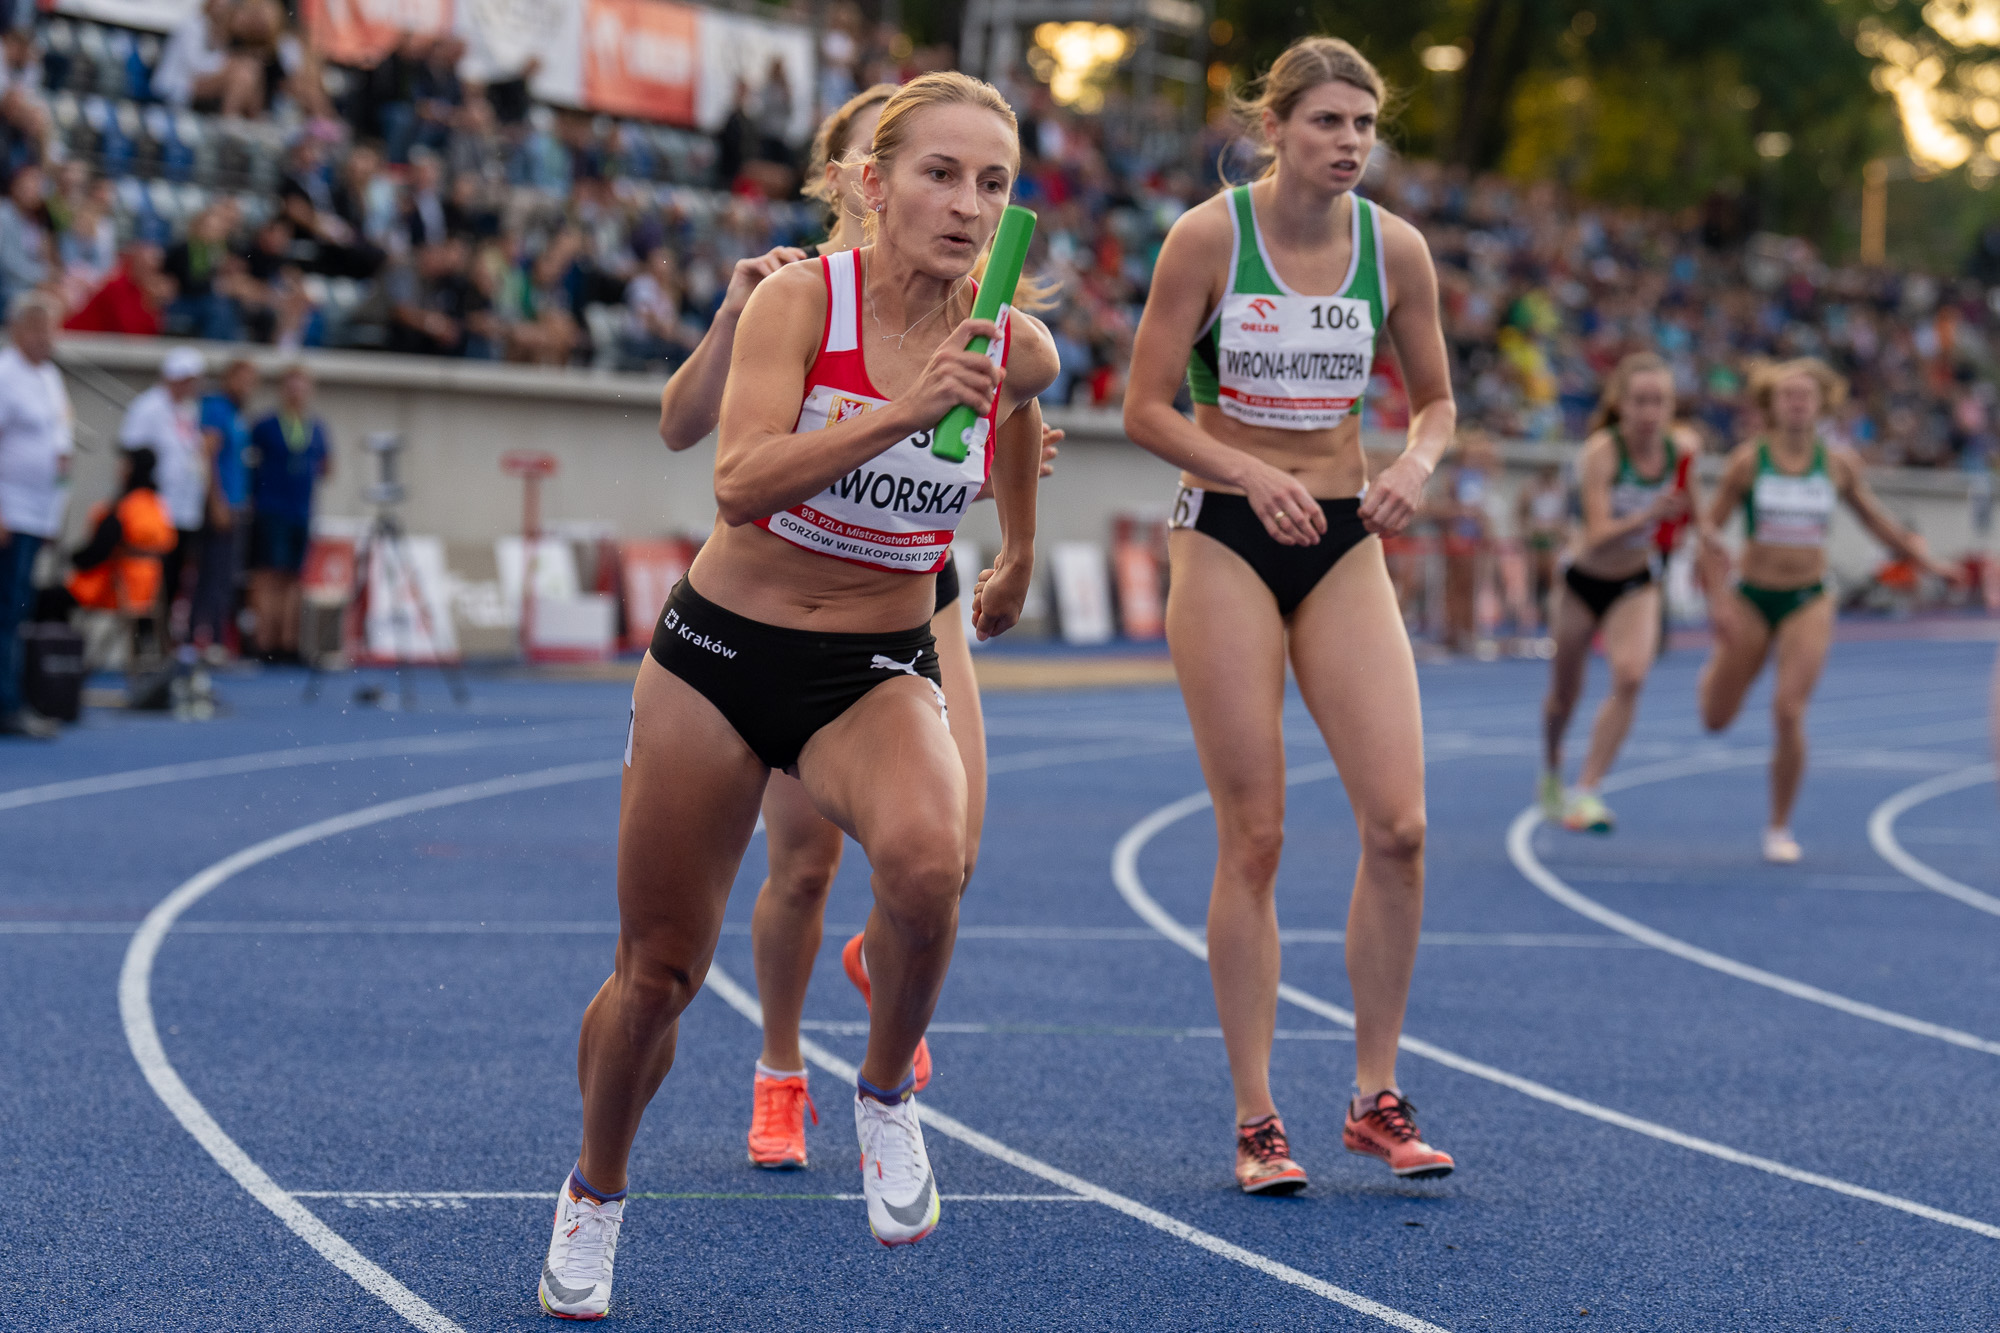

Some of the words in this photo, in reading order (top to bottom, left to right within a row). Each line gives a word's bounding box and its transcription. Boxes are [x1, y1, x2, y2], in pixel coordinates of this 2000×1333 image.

[1240, 322, 1279, 333] ORLEN
[1310, 304, 1360, 329] 106
[1226, 350, 1364, 381] WRONA-KUTRZEPA
[779, 517, 834, 546] GORZÓW
[836, 542, 921, 562] WIELKOPOLSKI
[800, 507, 816, 523] 99.
[817, 515, 844, 534] PZLA
[846, 528, 911, 546] Mistrzostwa
[911, 533, 936, 545] Polski
[677, 623, 738, 659] Kraków
